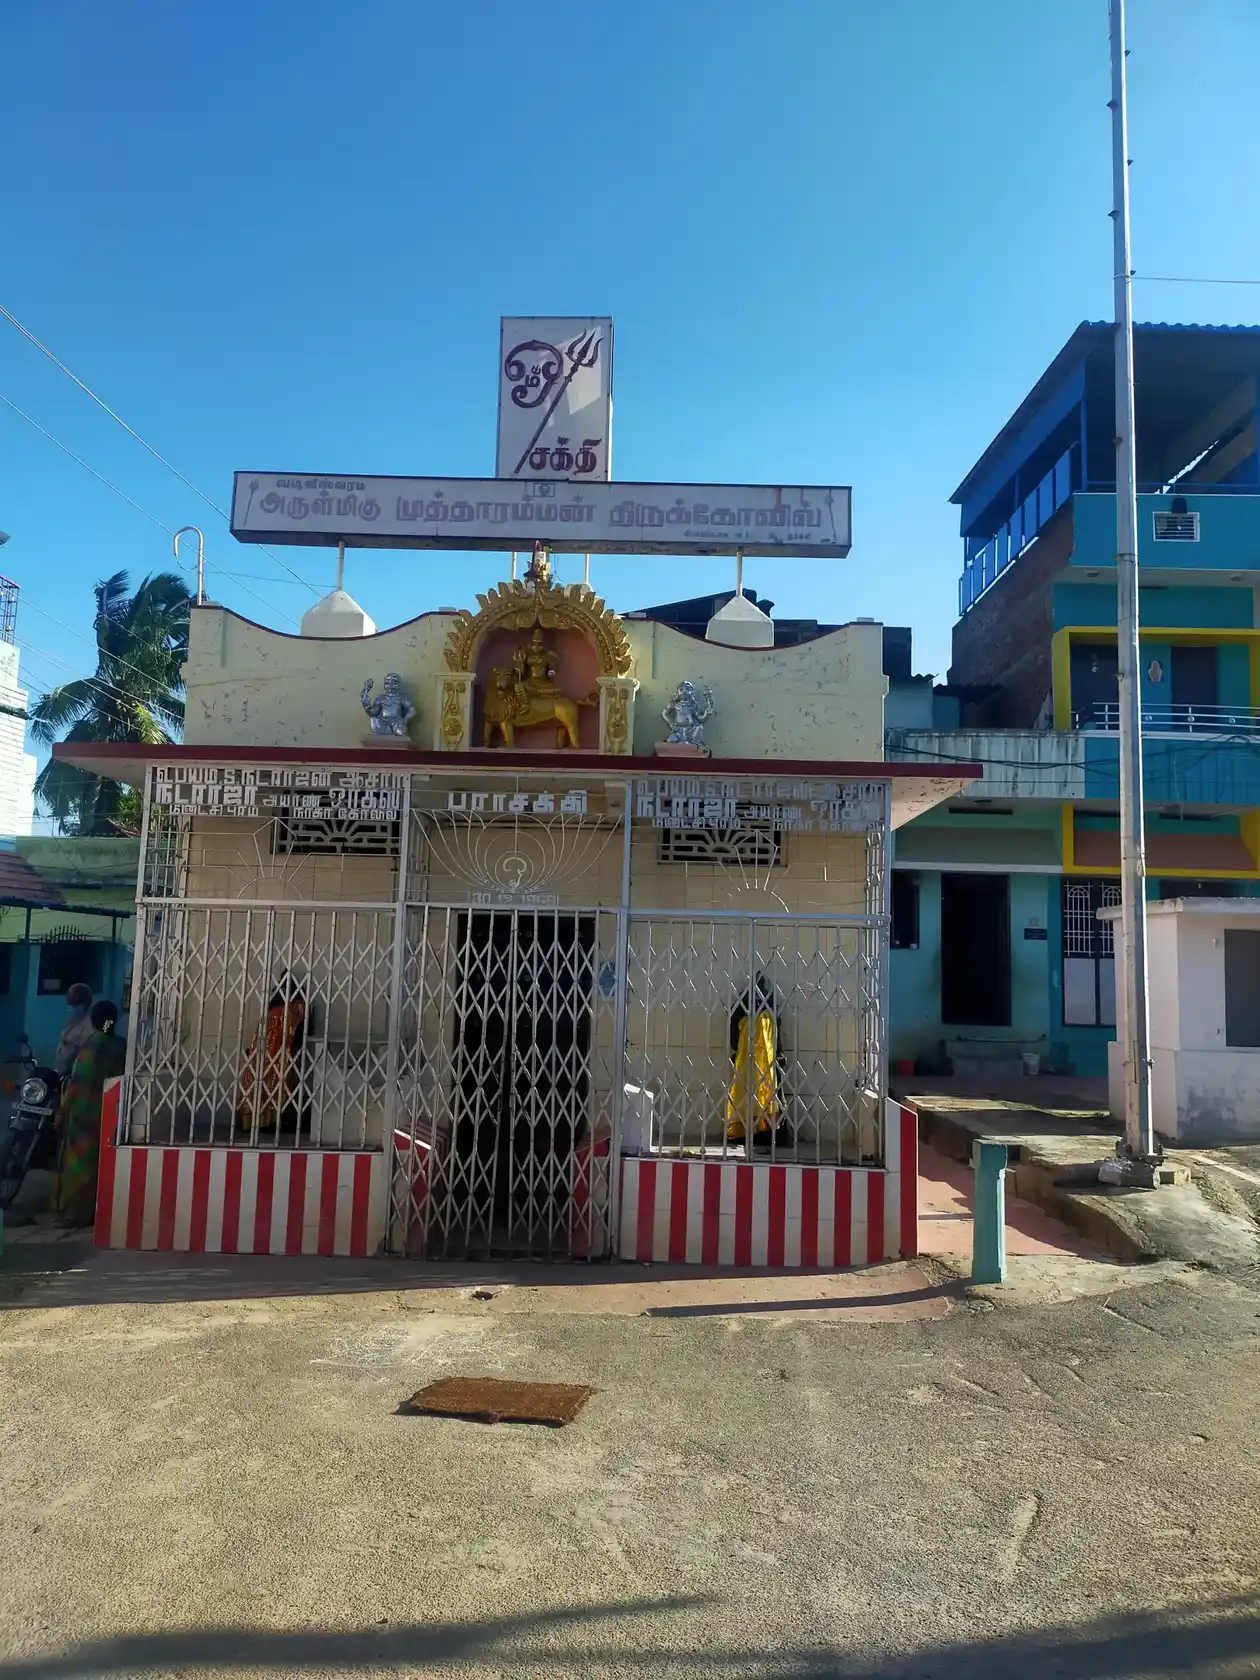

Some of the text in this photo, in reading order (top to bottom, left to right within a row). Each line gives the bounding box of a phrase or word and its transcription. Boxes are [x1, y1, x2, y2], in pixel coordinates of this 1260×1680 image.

[529, 436, 602, 475] சக்தி
[259, 490, 822, 529] அருள்மிகு முத்தாரம்மன் திருக்கோவில்
[156, 783, 258, 805] நடராஜா
[447, 789, 588, 813] பராசக்தி
